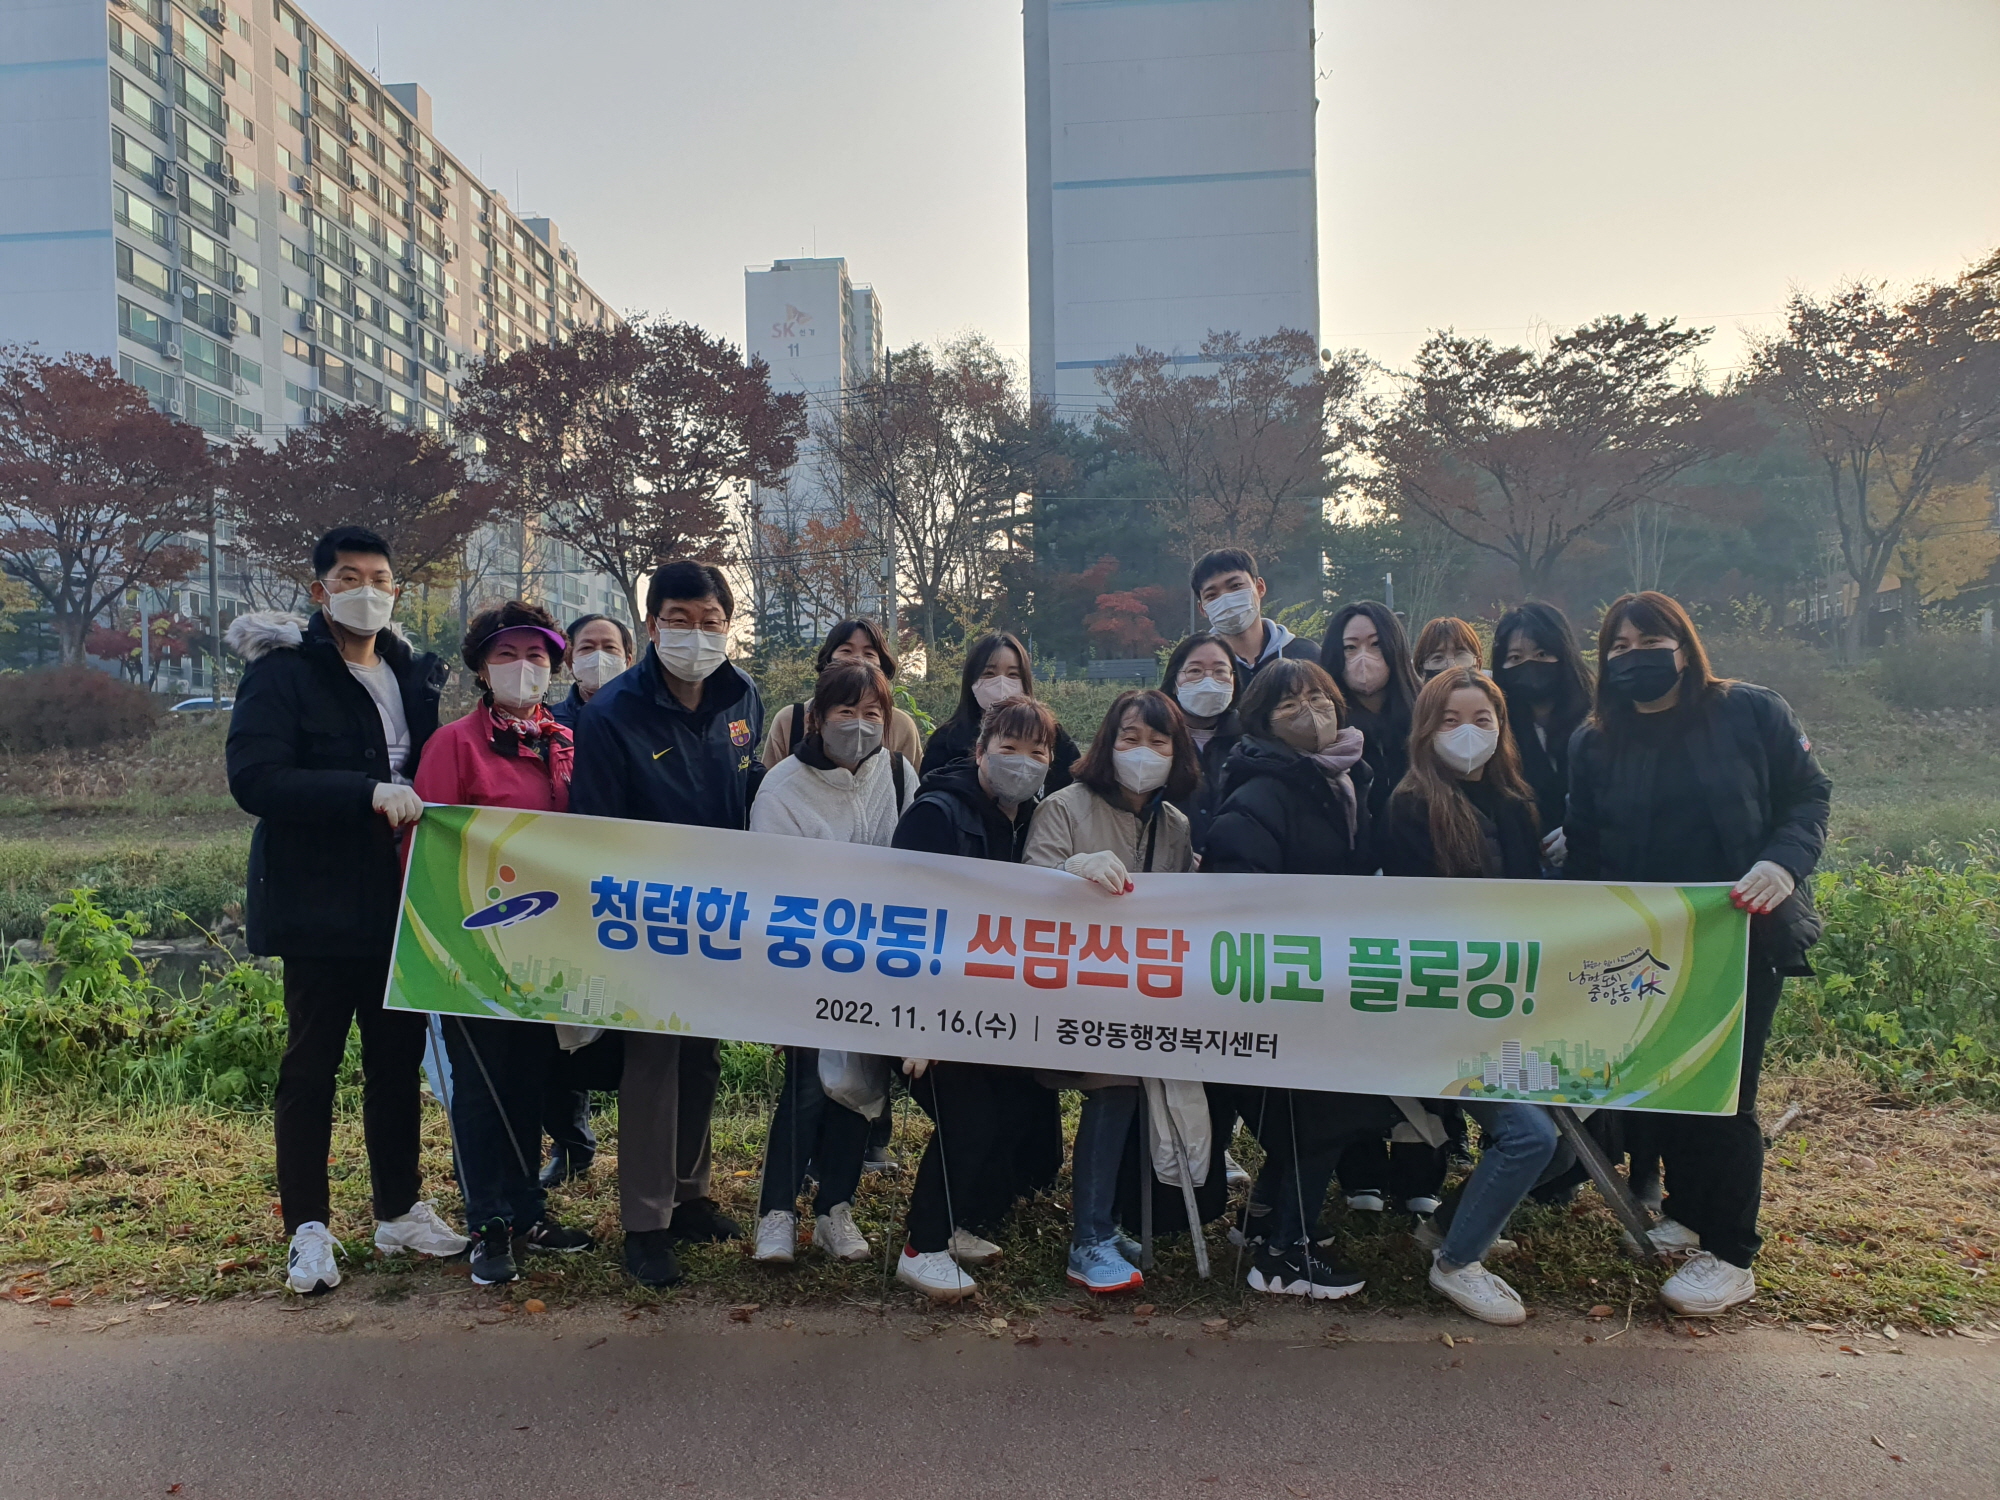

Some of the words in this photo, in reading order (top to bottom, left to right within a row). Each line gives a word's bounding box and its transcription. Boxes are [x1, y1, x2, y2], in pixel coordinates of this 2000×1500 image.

[771, 322, 795, 338] SK
[787, 343, 799, 357] 11
[590, 875, 750, 961] 청렴한
[765, 894, 948, 978] 중앙동!
[964, 913, 1190, 999] 쓰담쓰담
[1210, 930, 1324, 1003] 에코
[1348, 937, 1541, 1019] 플로깅!
[1588, 984, 1632, 1005] 중앙동
[815, 998, 880, 1027] 2022.
[891, 1005, 925, 1031] 11.
[937, 1009, 1017, 1040] 16.(수)
[1056, 1018, 1278, 1059] 중앙동행정복지센터
